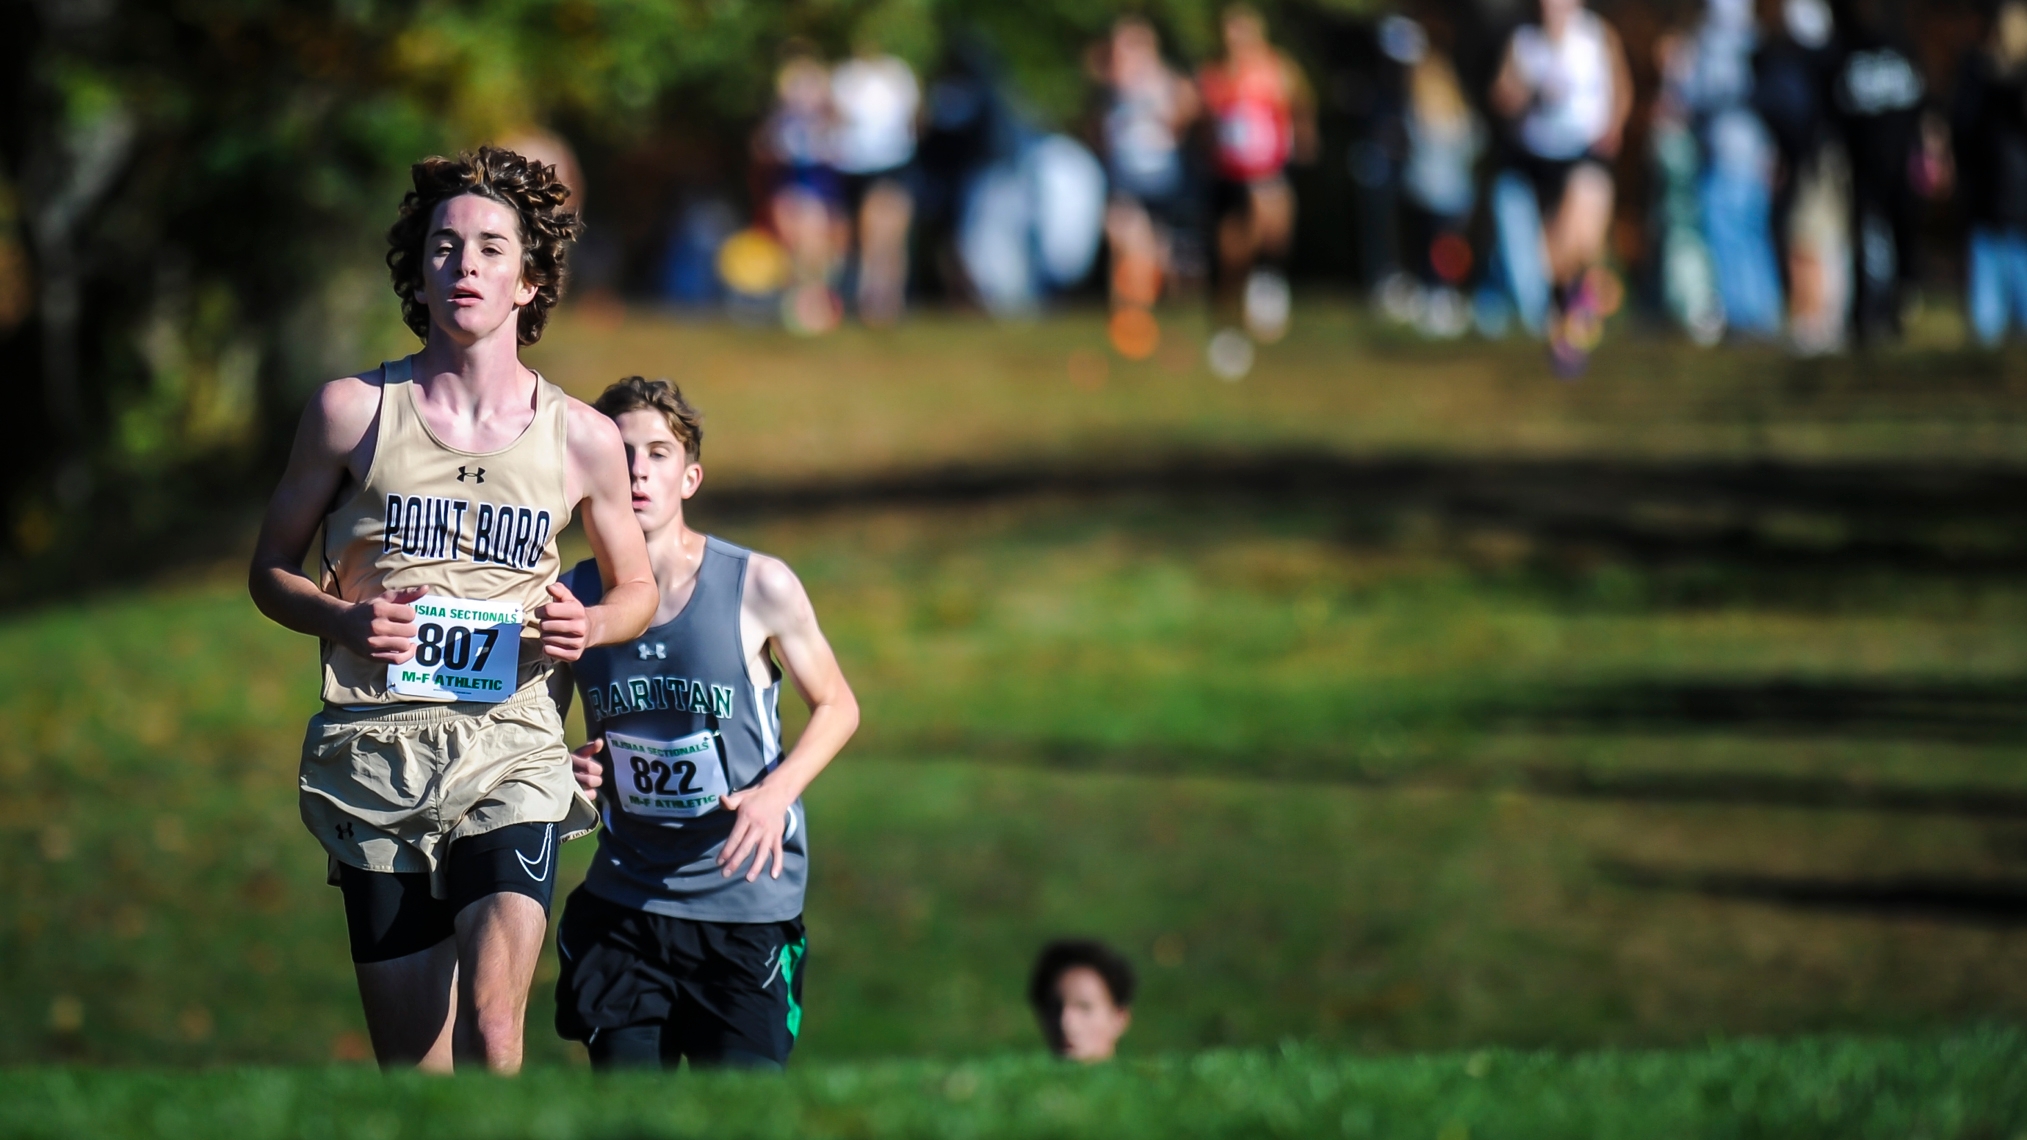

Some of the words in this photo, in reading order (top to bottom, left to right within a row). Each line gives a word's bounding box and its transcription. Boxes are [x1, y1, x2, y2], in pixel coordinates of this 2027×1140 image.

[383, 493, 468, 560] POINT
[472, 503, 550, 569] BORO
[450, 608, 517, 624] SECTIONALS
[415, 622, 499, 672] 807
[402, 671, 430, 683] M-F
[434, 674, 503, 691] ATHLETIC
[588, 676, 734, 721] RARITAN
[647, 741, 709, 757] SECTIONALS
[629, 756, 703, 795] 822
[628, 795, 651, 807] M-F
[655, 794, 717, 808] ATHLETIC
